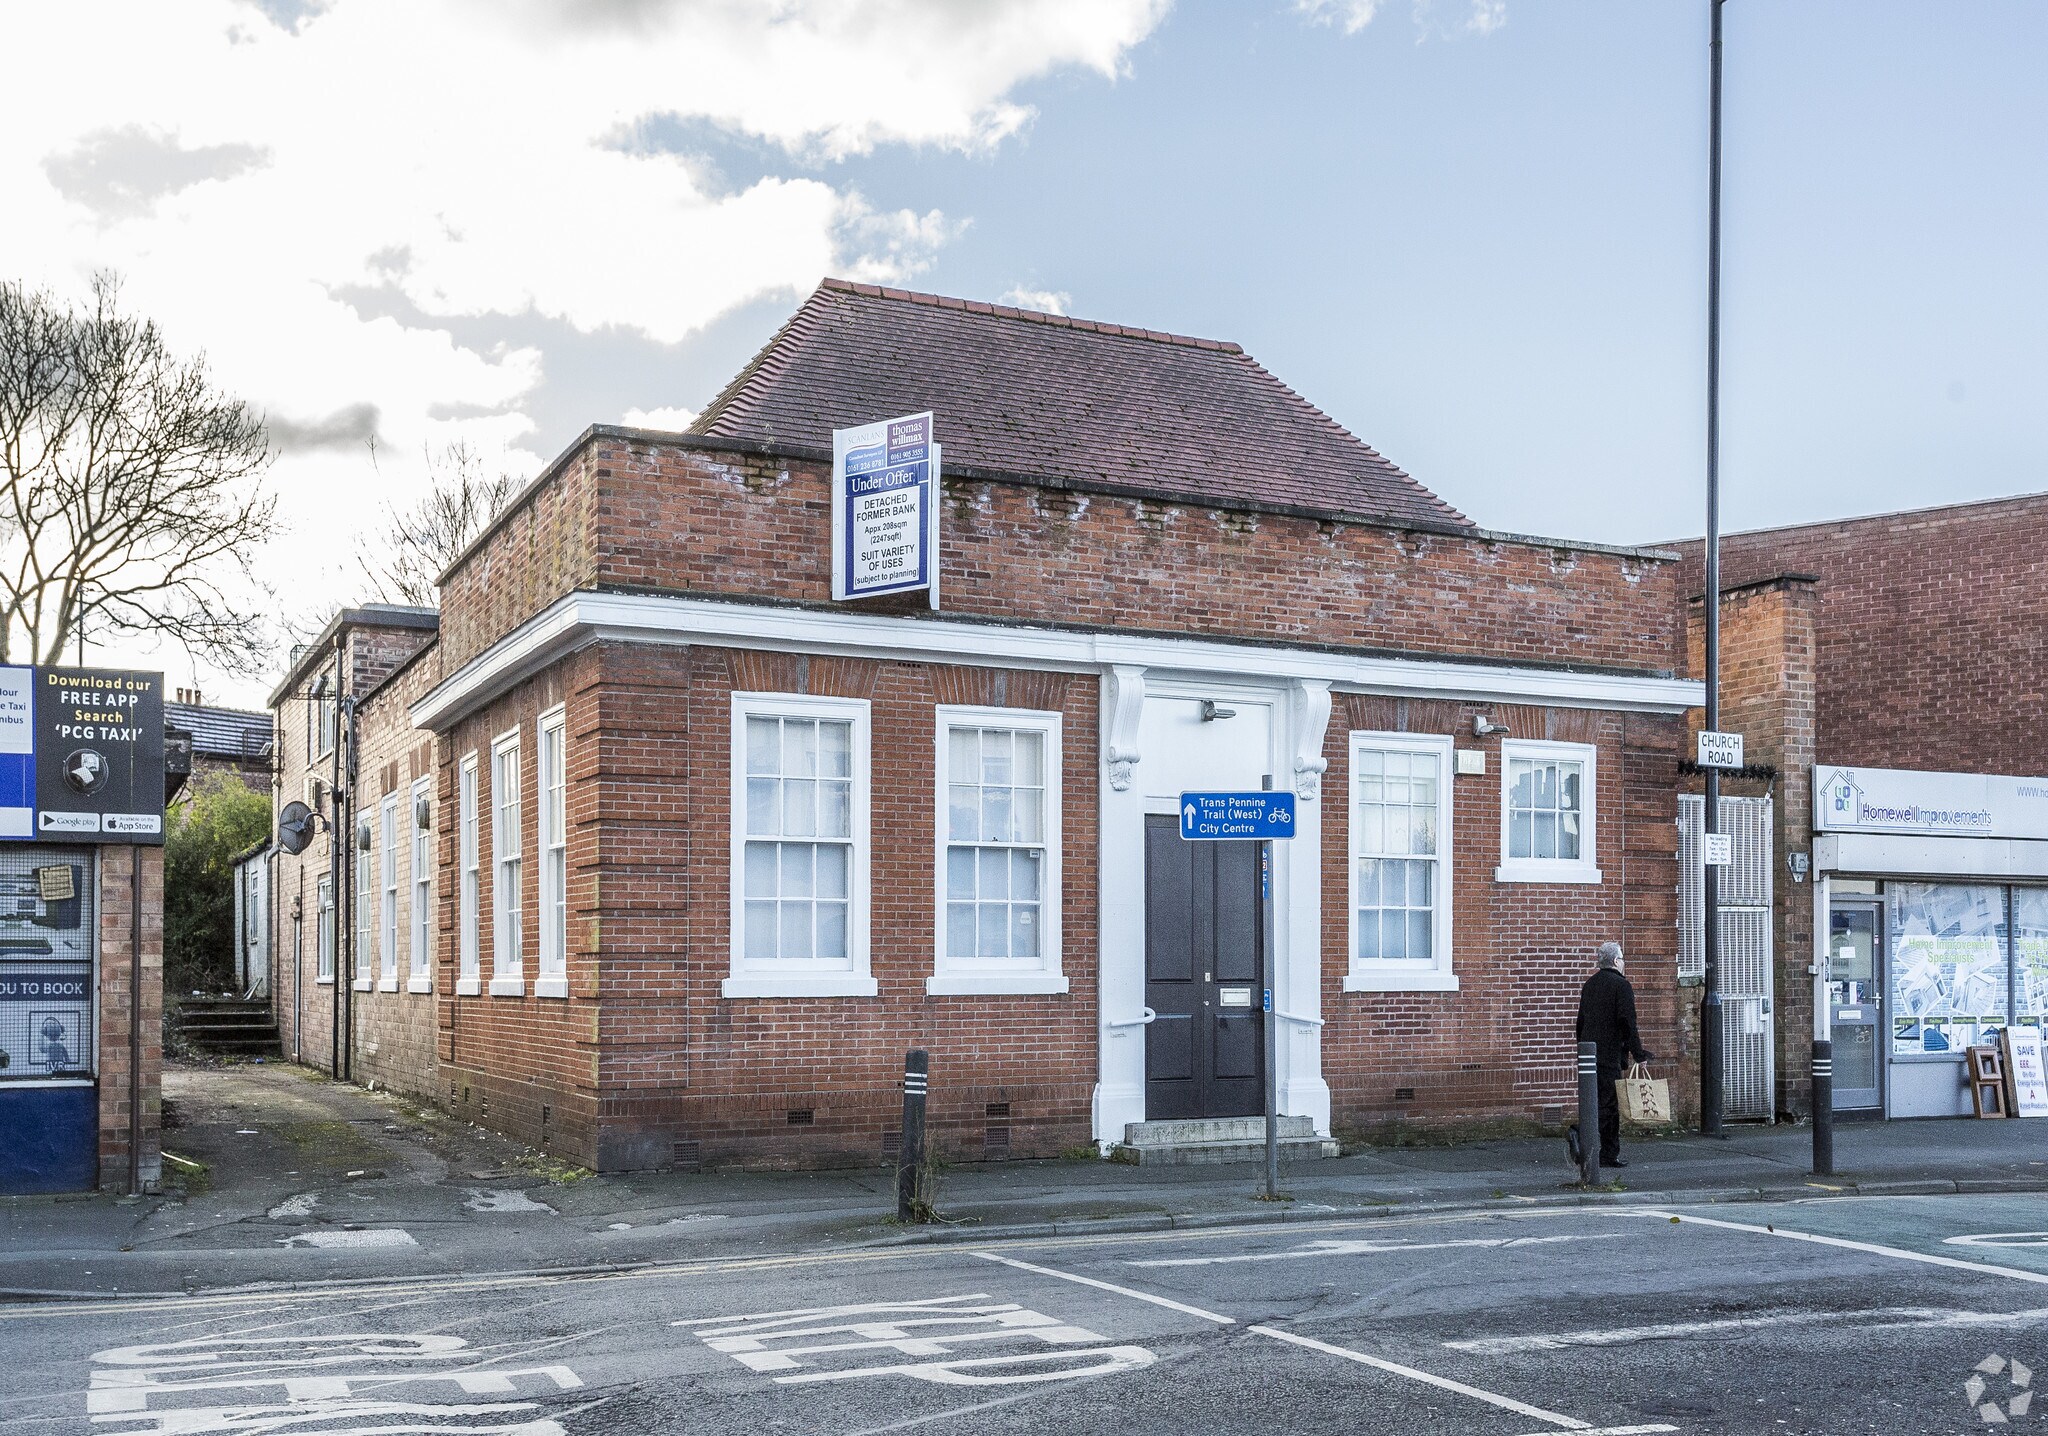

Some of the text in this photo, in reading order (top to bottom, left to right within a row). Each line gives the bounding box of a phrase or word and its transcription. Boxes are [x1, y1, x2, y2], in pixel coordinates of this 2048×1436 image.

[892, 422, 923, 436] thomas
[847, 429, 885, 444] SCANLANS
[892, 433, 923, 446] willmax
[852, 470, 914, 493] Under Offer
[864, 494, 908, 509] DETACHED
[856, 503, 916, 522] FORMER BANK
[864, 520, 908, 535] Appx 208sqm
[870, 532, 902, 545] (2247sqft)
[861, 544, 915, 562] SUIT VARIETY
[868, 558, 904, 571] OF USES
[854, 574, 880, 586] (subject
[890, 568, 919, 580] planning)
[48, 674, 150, 691] Download our
[0, 688, 18, 696] our
[8, 702, 26, 710] Taxi
[60, 691, 138, 708] FREE APP
[75, 710, 123, 723] Search
[1702, 734, 1740, 749] CHURCH
[1708, 751, 1734, 764] ROAD
[1199, 798, 1266, 807] Trans Pennine
[1203, 808, 1262, 820] Trail (West)
[57, 818, 96, 827] Google play
[119, 822, 154, 830] App Store
[1200, 823, 1254, 835] City Centre
[1908, 938, 1992, 951] Home Improvement
[20, 982, 40, 994] TO
[44, 982, 83, 994] BOOK
[2016, 1046, 2035, 1056] SAVE
[46, 1061, 65, 1071] IVR
[2030, 1090, 2036, 1100] A
[671, 1293, 1159, 1386] KEEP
[87, 1334, 585, 1436] CLEA
